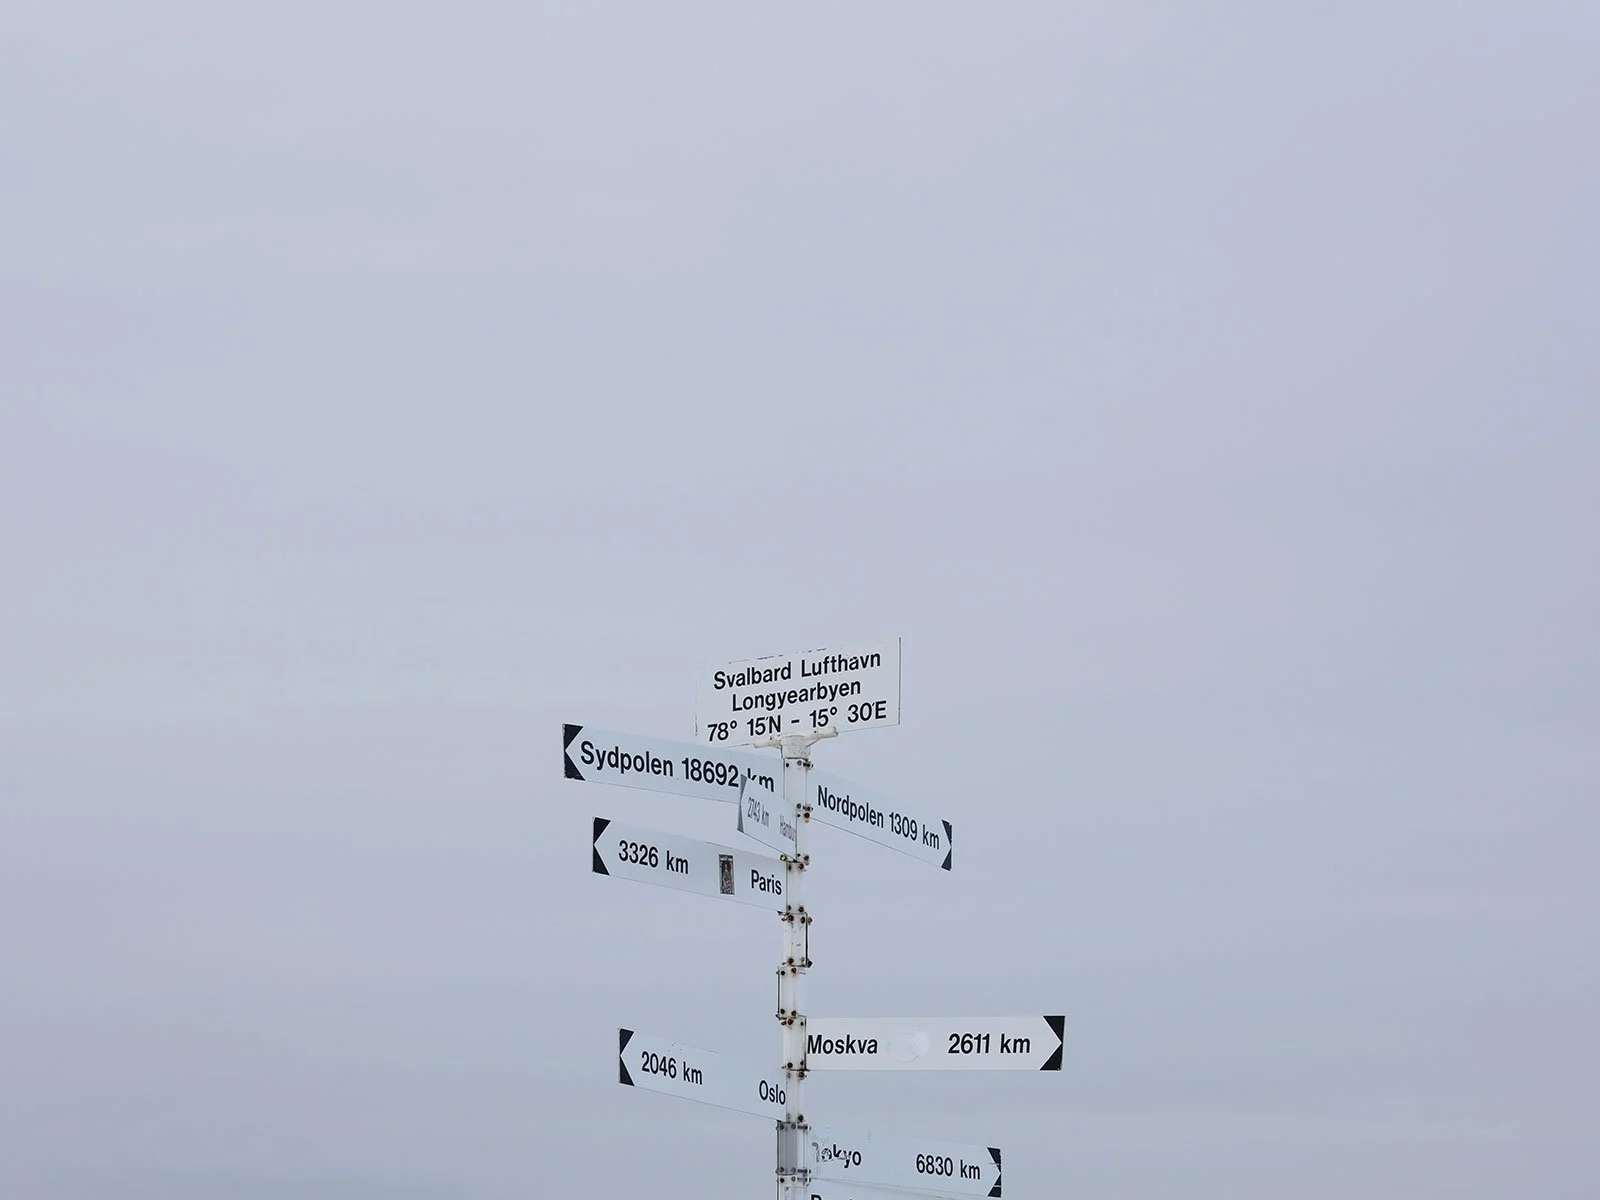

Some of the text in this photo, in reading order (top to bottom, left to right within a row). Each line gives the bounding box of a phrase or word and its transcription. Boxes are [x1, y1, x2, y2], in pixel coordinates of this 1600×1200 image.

[714, 650, 881, 689] Svalbard Lufthavn
[732, 679, 861, 711] Longyearbyen
[708, 720, 737, 741] 78°
[810, 707, 837, 727] 15°
[581, 741, 673, 779] Sydpolen
[682, 758, 739, 787] 18692
[818, 785, 939, 849] Nordpolen 1309 km
[619, 840, 781, 895] 3326 km Paris
[807, 1033, 1030, 1054] Moskva 2611 km
[642, 1051, 785, 1105] 2046 km Oslo
[916, 1154, 953, 1176] 6830
[961, 1159, 980, 1179] km
